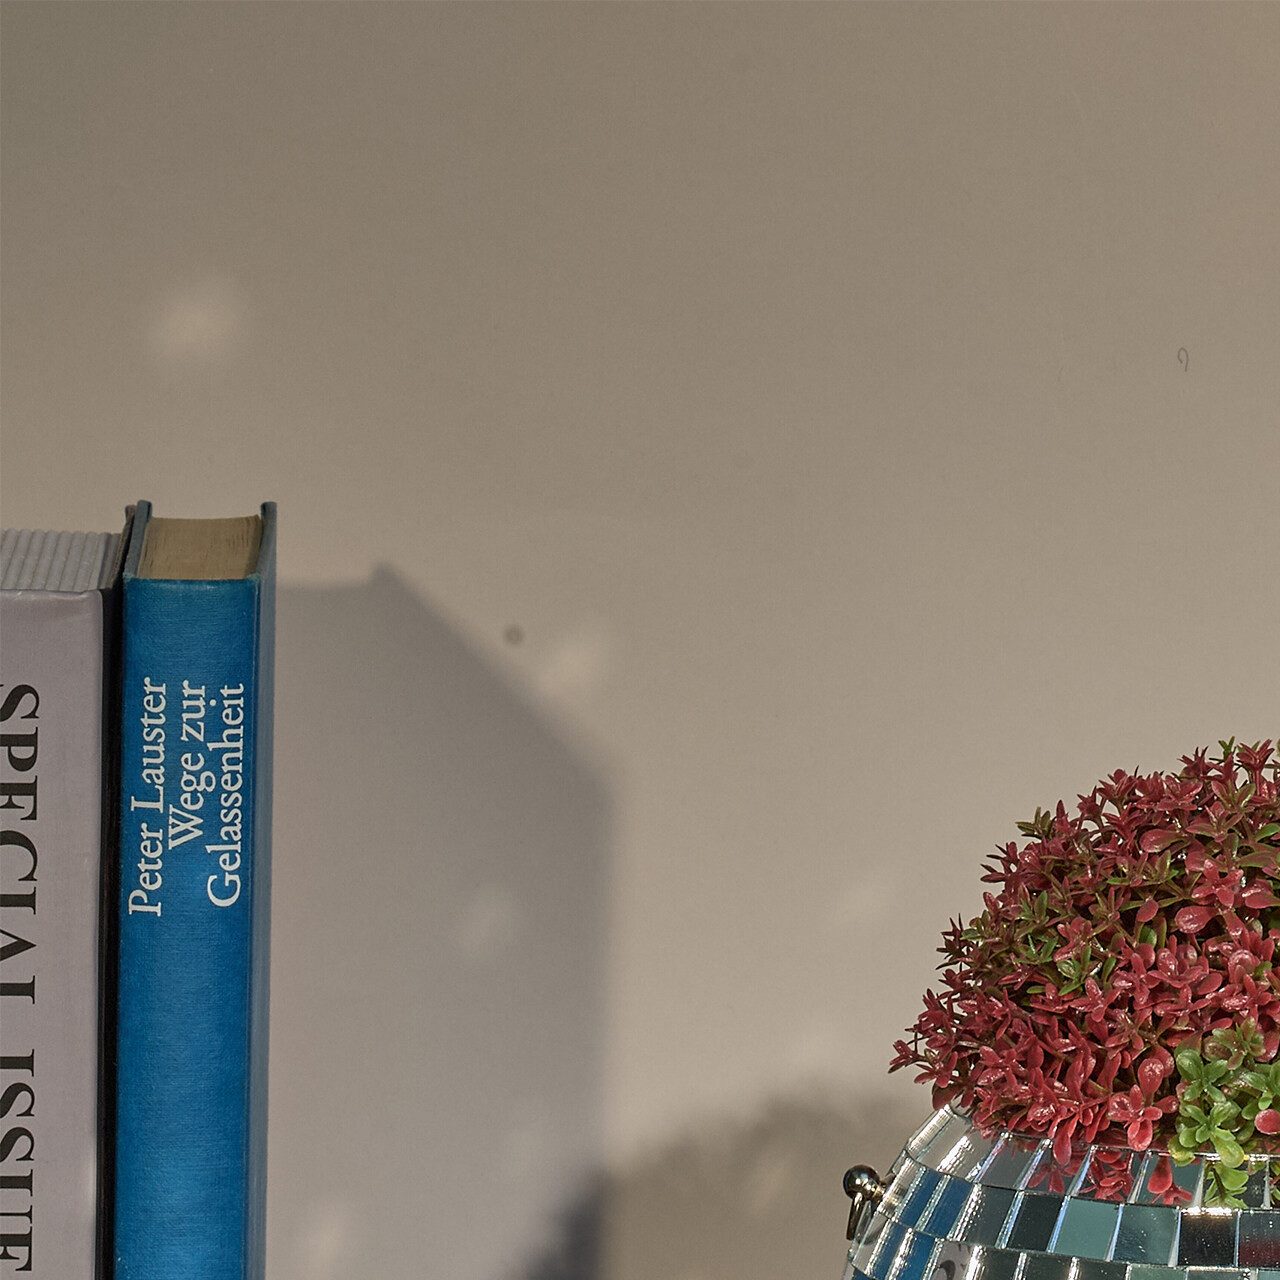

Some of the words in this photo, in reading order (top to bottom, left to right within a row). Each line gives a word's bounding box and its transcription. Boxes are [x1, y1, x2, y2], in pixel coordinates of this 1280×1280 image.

[131, 677, 166, 814] Lauster
[180, 680, 206, 742] zur
[168, 753, 216, 850] Wege
[205, 683, 245, 907] Gelassenheit
[128, 823, 163, 917] Peter
